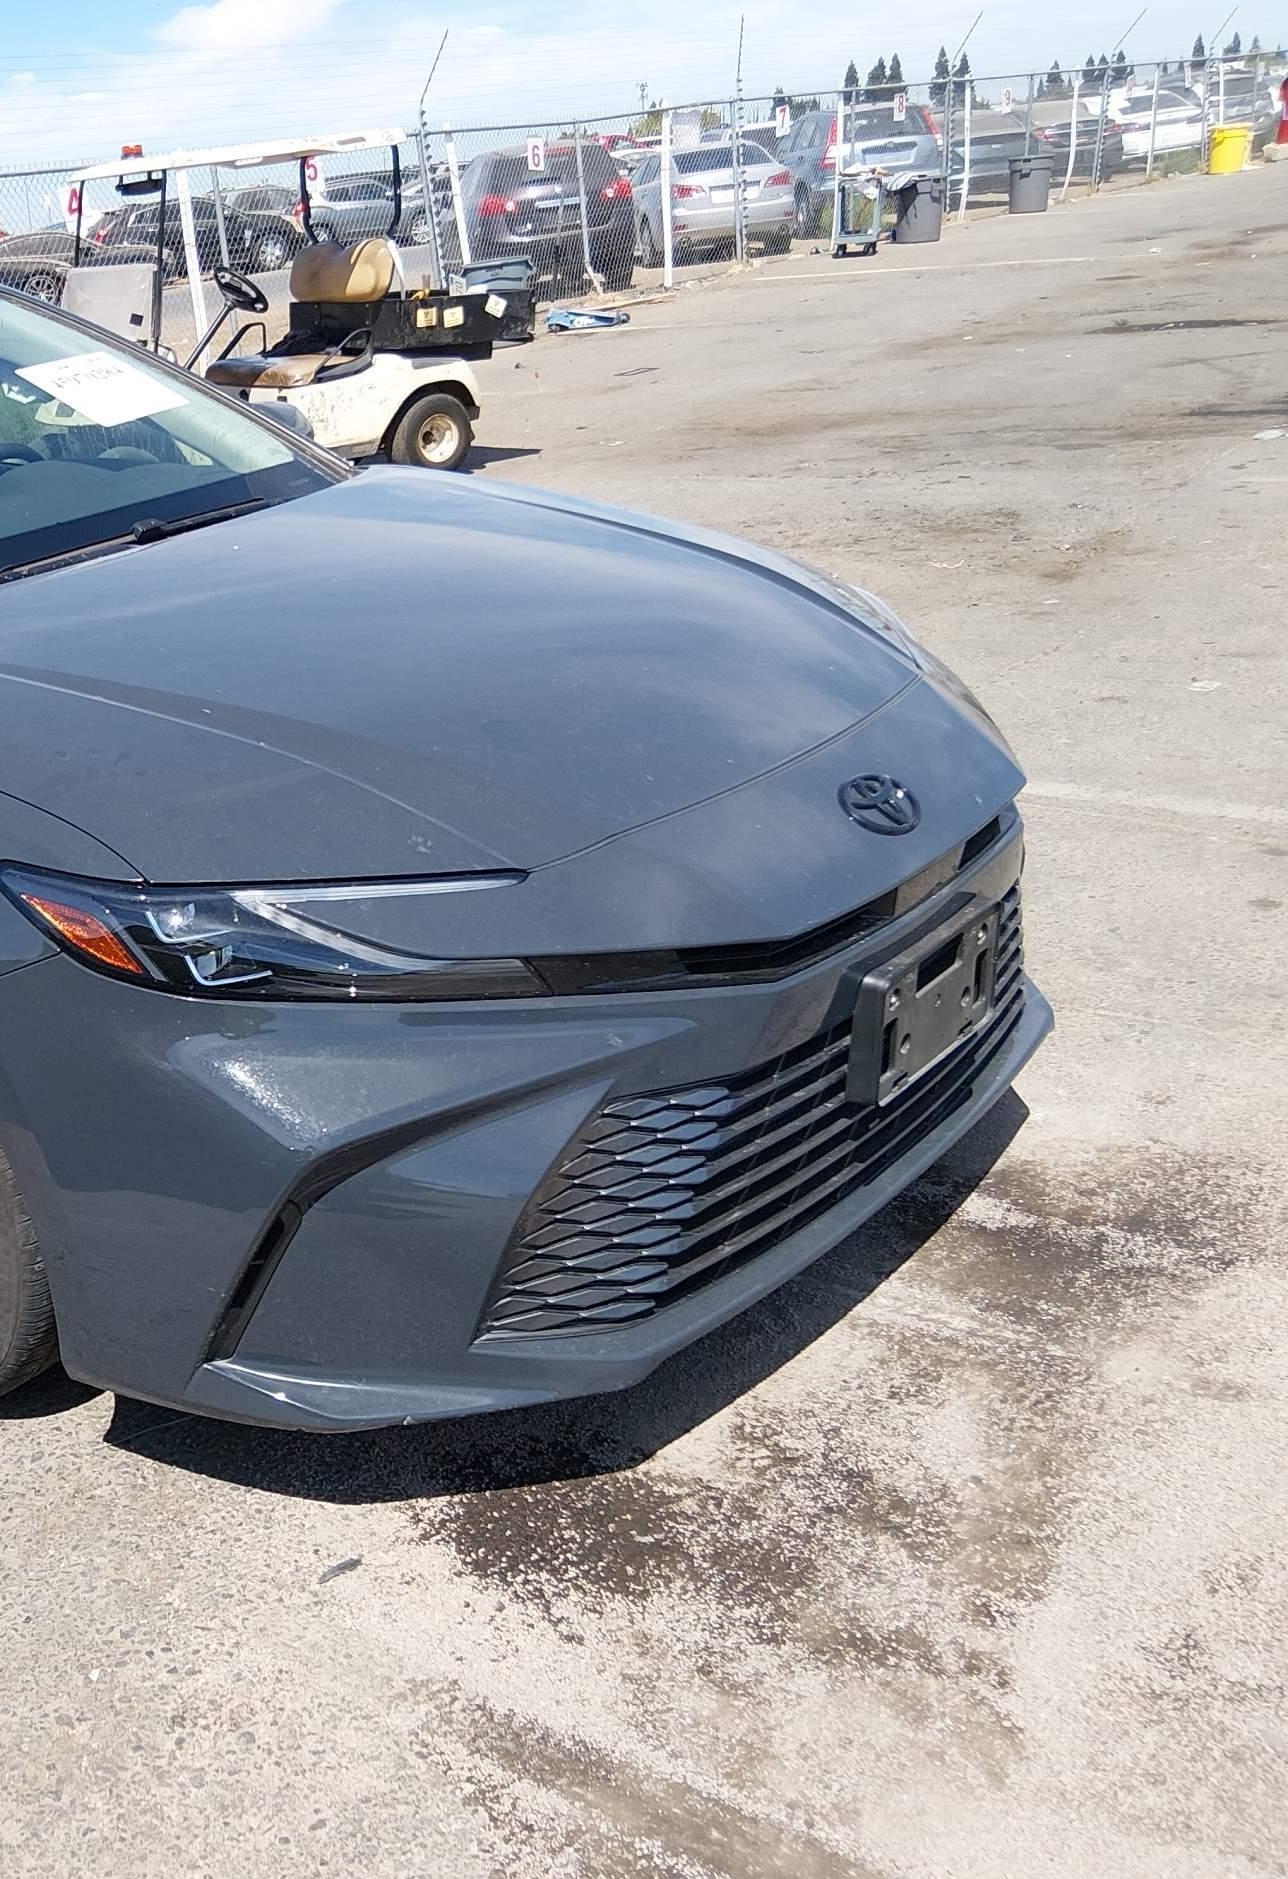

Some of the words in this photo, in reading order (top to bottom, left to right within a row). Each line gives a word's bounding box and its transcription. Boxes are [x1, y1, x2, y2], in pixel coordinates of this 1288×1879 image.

[898, 95, 904, 113] 8
[1005, 89, 1011, 106] 9
[779, 107, 787, 129] 7
[532, 144, 541, 169] 6
[305, 156, 318, 182] 5
